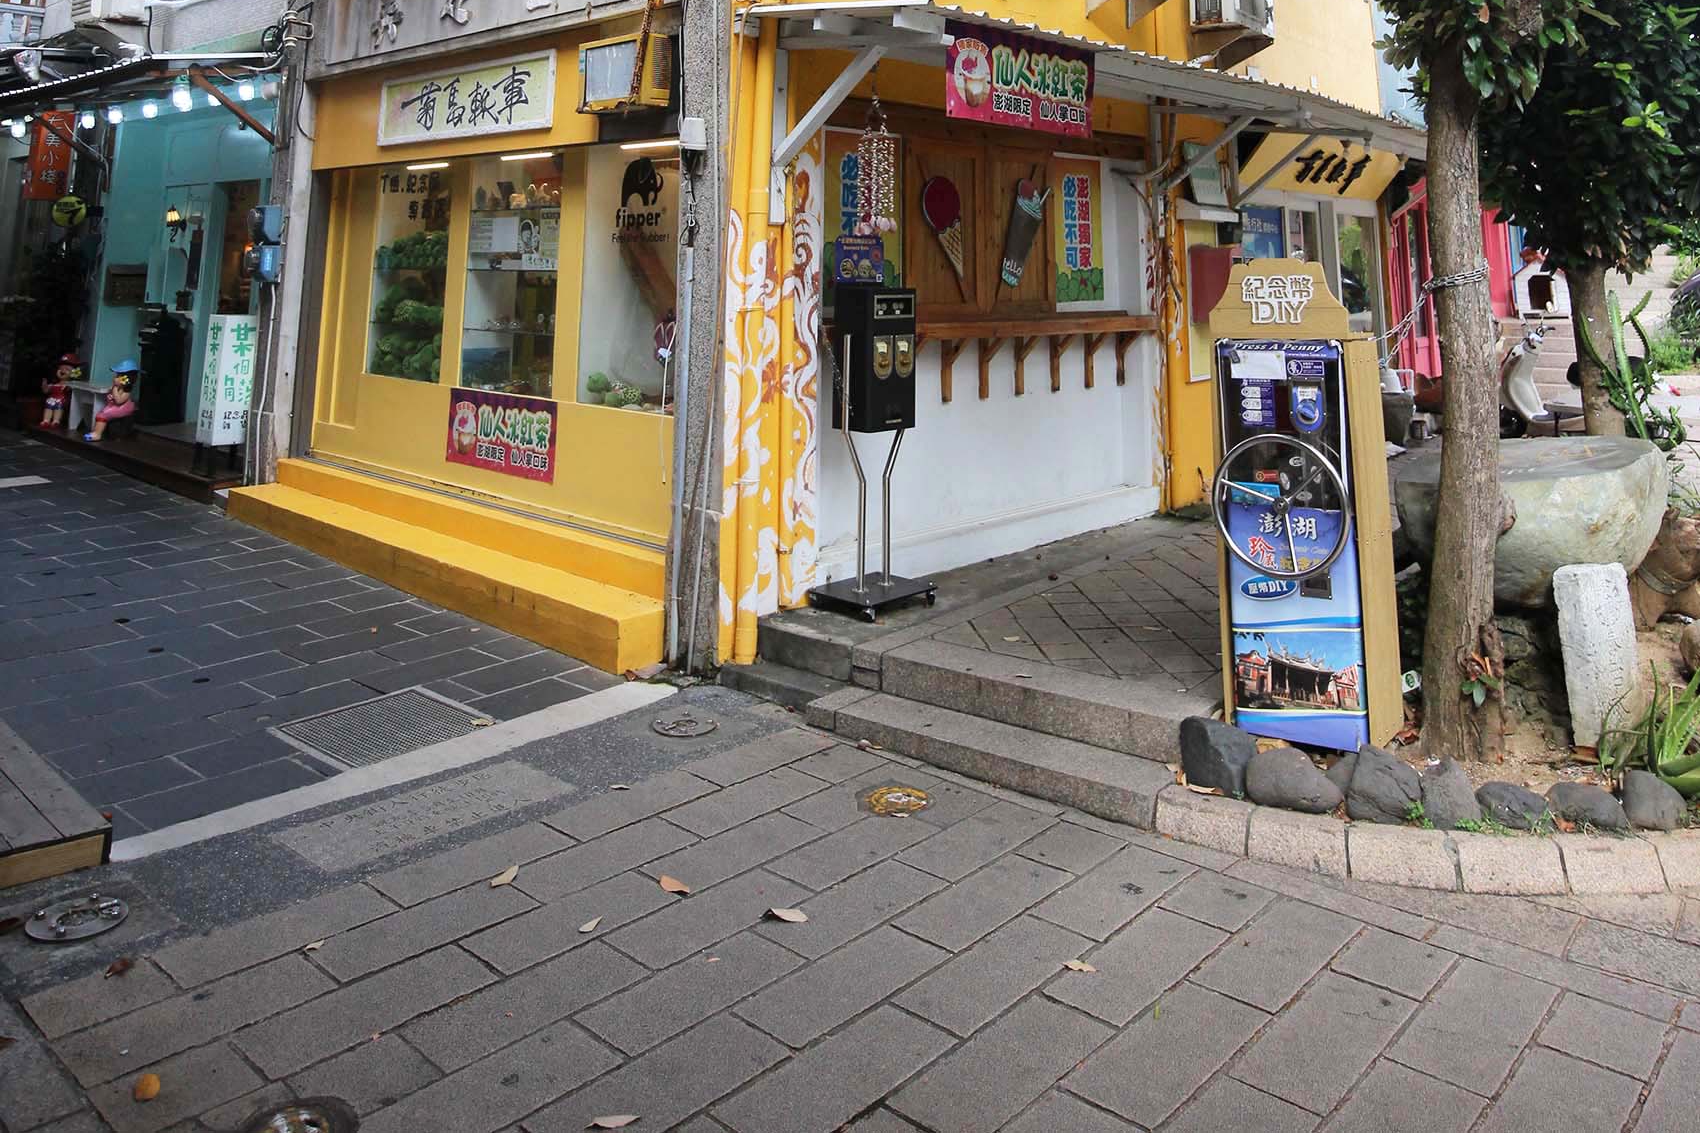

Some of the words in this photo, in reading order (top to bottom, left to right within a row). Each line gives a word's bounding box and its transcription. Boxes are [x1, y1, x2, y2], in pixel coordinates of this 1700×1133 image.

[993, 48, 1086, 103] 仙人冰紅茶
[993, 92, 1032, 117] 澎湖限定
[1040, 101, 1086, 124] 仙人掌口味
[615, 208, 661, 231] fipper
[1063, 174, 1078, 269] 必吃不可
[1243, 275, 1312, 302] 紀念幣
[1251, 300, 1307, 323] DIY
[1233, 342, 1266, 351] Press
[1269, 342, 1279, 351] A
[1281, 342, 1325, 353] Penny
[478, 406, 551, 451] 仙人冰紅茶
[1258, 511, 1318, 541] 澎湖
